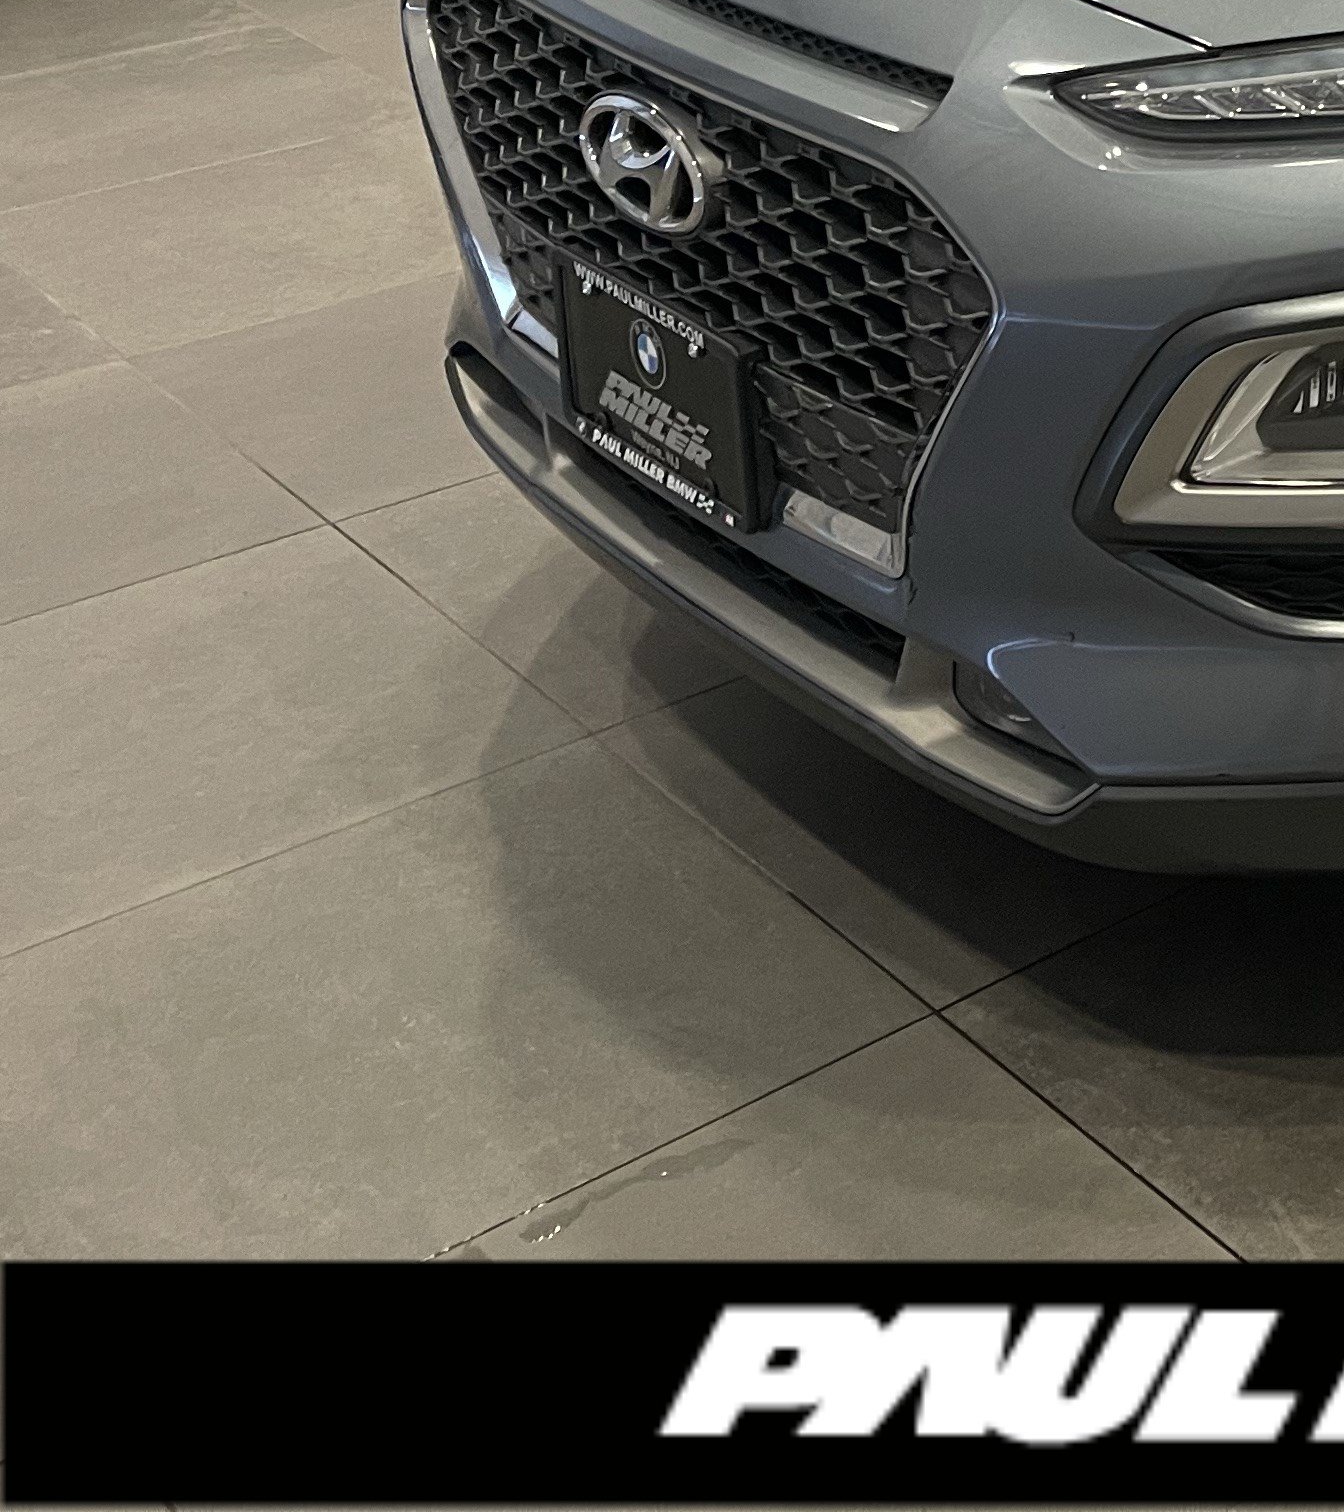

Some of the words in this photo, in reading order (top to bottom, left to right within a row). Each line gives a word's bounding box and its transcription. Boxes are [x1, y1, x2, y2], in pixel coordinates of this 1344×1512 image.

[598, 387, 712, 470] MILLER
[606, 370, 673, 426] PAUL
[592, 428, 622, 458] PAUL
[623, 446, 665, 484] MILLER
[666, 474, 698, 504] BMW
